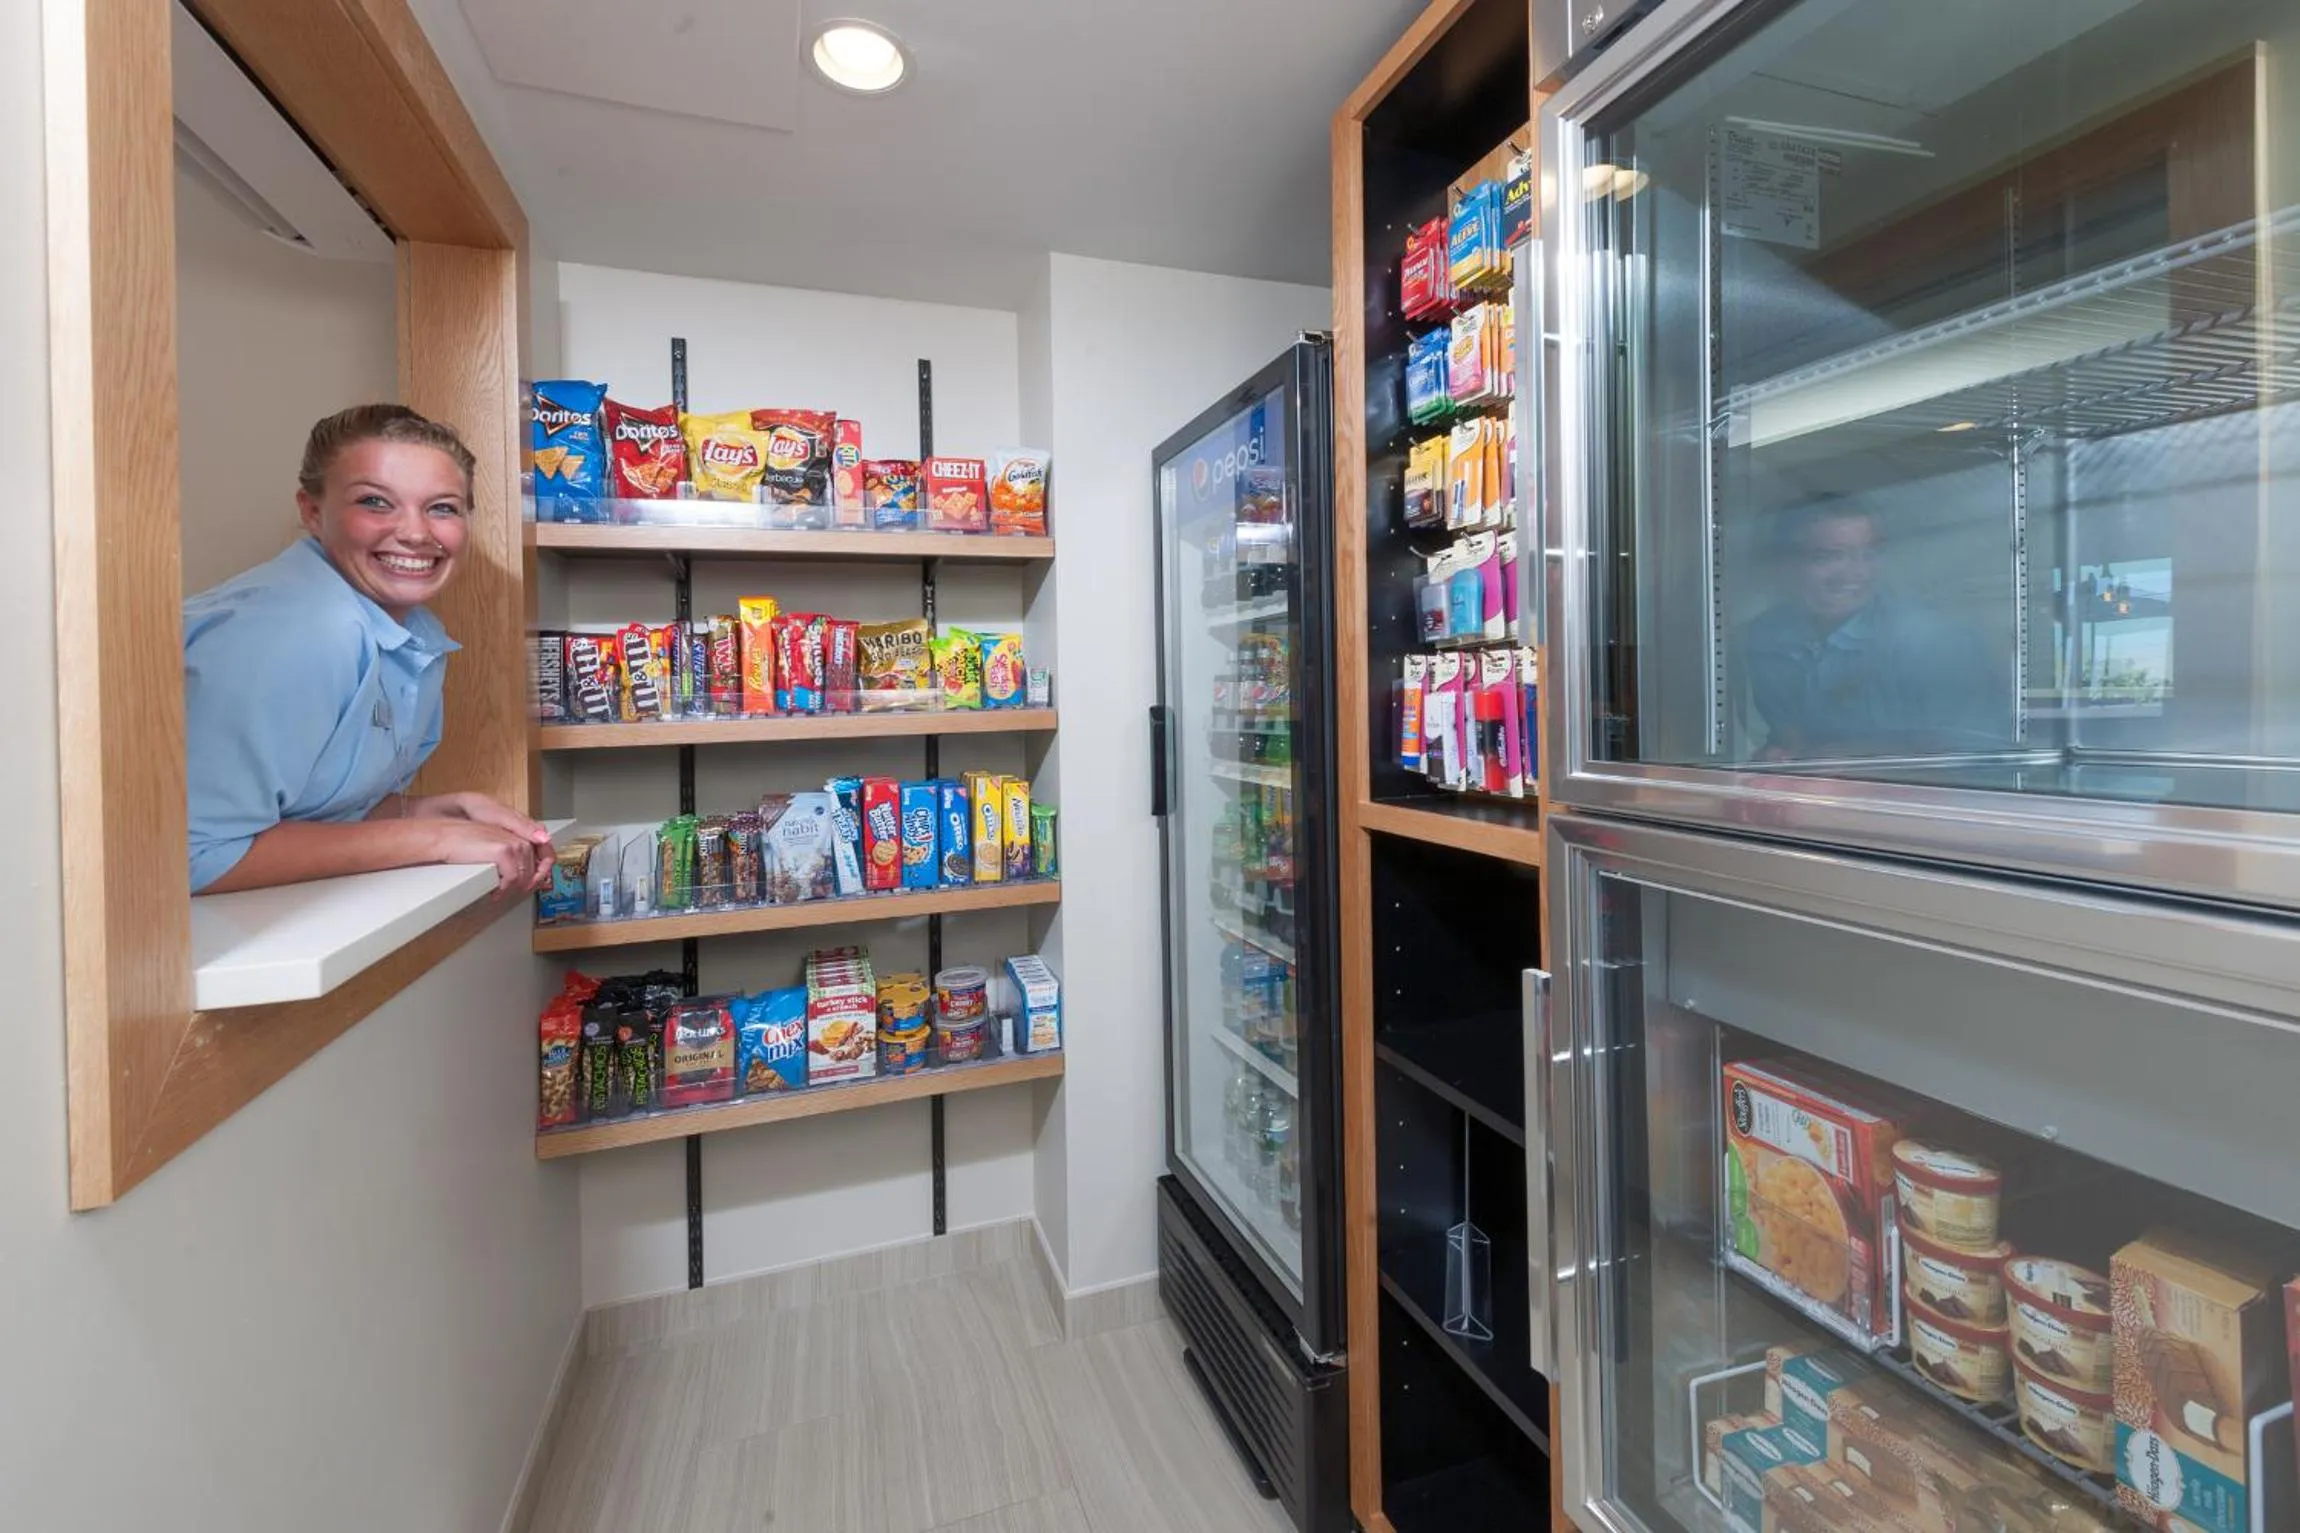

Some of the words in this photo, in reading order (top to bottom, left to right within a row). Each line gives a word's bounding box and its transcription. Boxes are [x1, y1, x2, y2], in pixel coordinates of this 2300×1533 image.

[531, 406, 592, 427] Doritos
[615, 424, 679, 441] Doritos
[704, 440, 755, 467] Lay's
[769, 436, 804, 458] Lay's
[1211, 426, 1266, 494] pepsi
[931, 461, 980, 480] CHEEZ-IT
[863, 631, 922, 649] HARIBO
[880, 802, 898, 837] Nutter
[917, 807, 932, 837] Chips
[949, 812, 964, 850] OREO
[763, 1018, 804, 1047] Chex
[768, 1038, 804, 1063] mix
